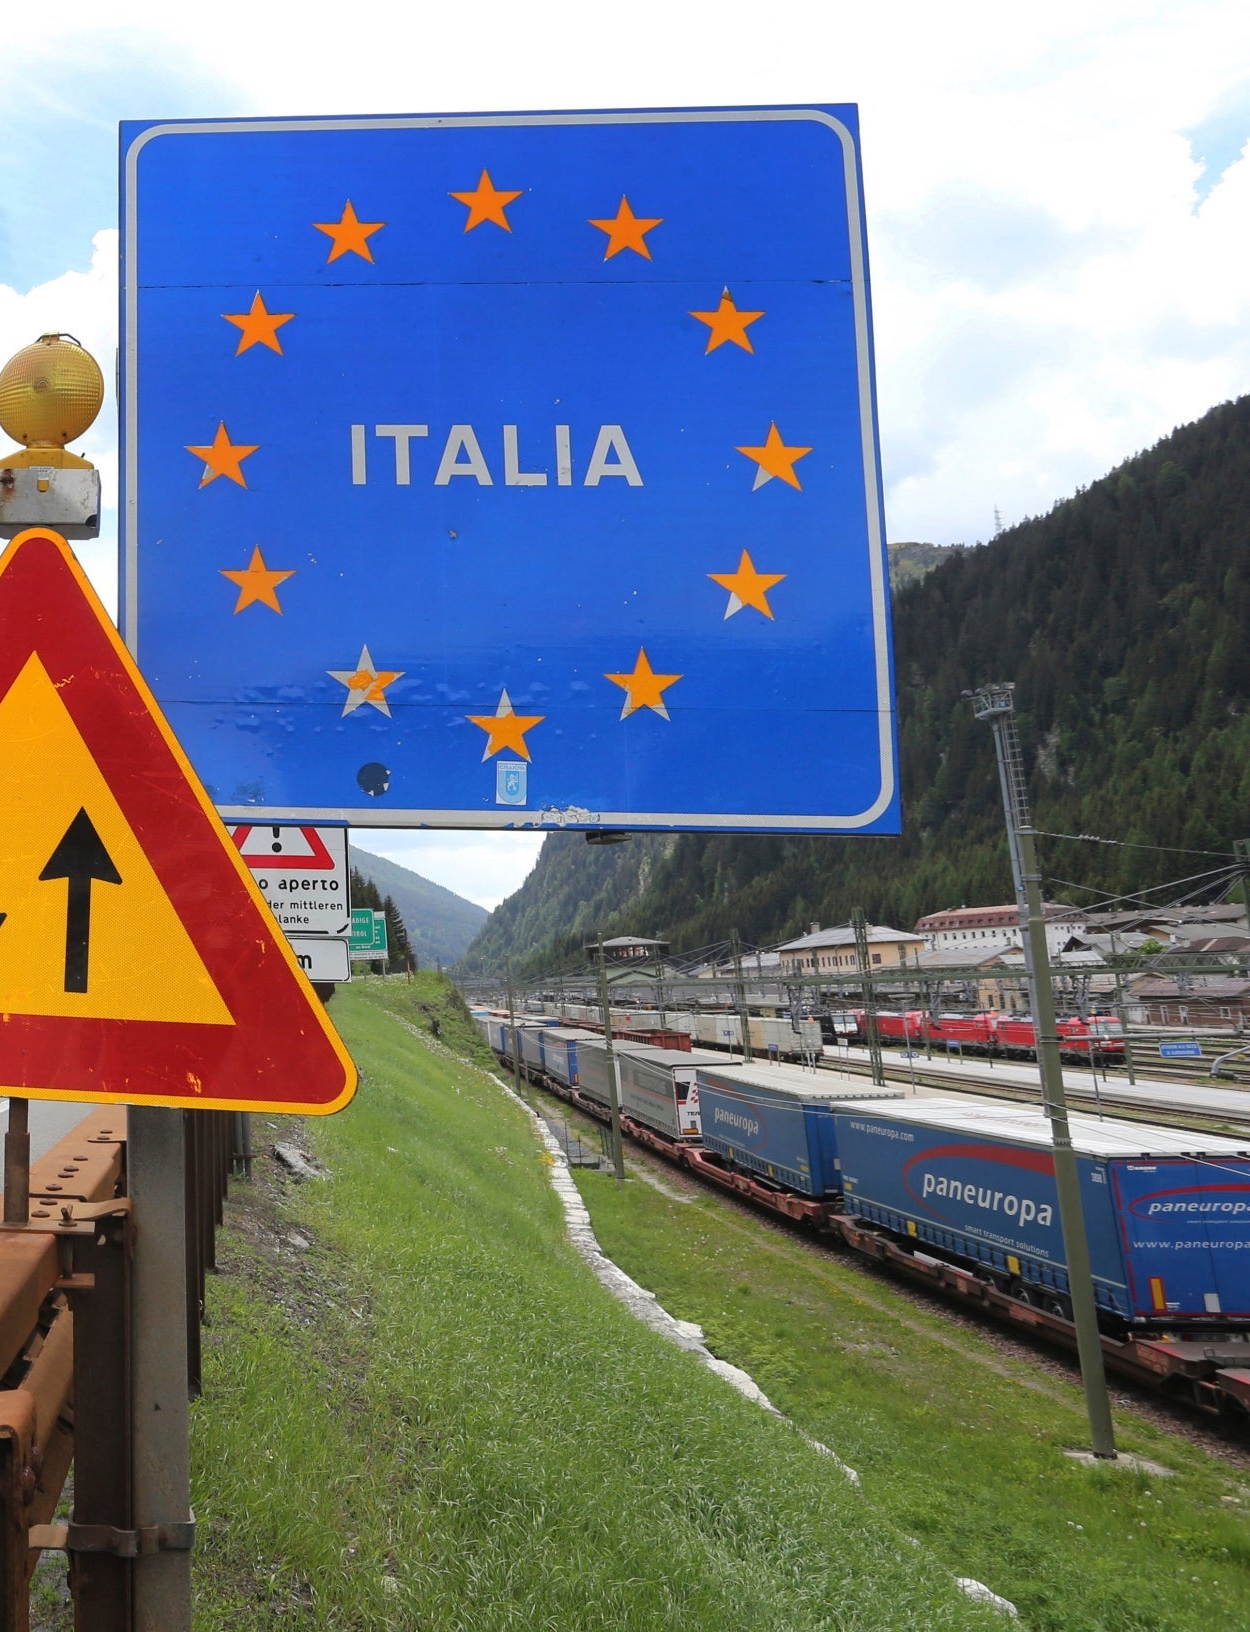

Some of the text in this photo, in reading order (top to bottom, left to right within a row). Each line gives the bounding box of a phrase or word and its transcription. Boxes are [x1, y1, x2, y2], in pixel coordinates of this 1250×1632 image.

[351, 424, 644, 486] ITALIA
[258, 879, 339, 893] o aperto
[290, 900, 343, 910] mittleren
[277, 914, 309, 923] lanke
[714, 1106, 759, 1136] paneuropa
[850, 1121, 914, 1142] www.paneuropa.com
[922, 1173, 1053, 1227] paneuropa
[1148, 1202, 1250, 1215] paneurop
[964, 1224, 1049, 1258] smart transport solutions
